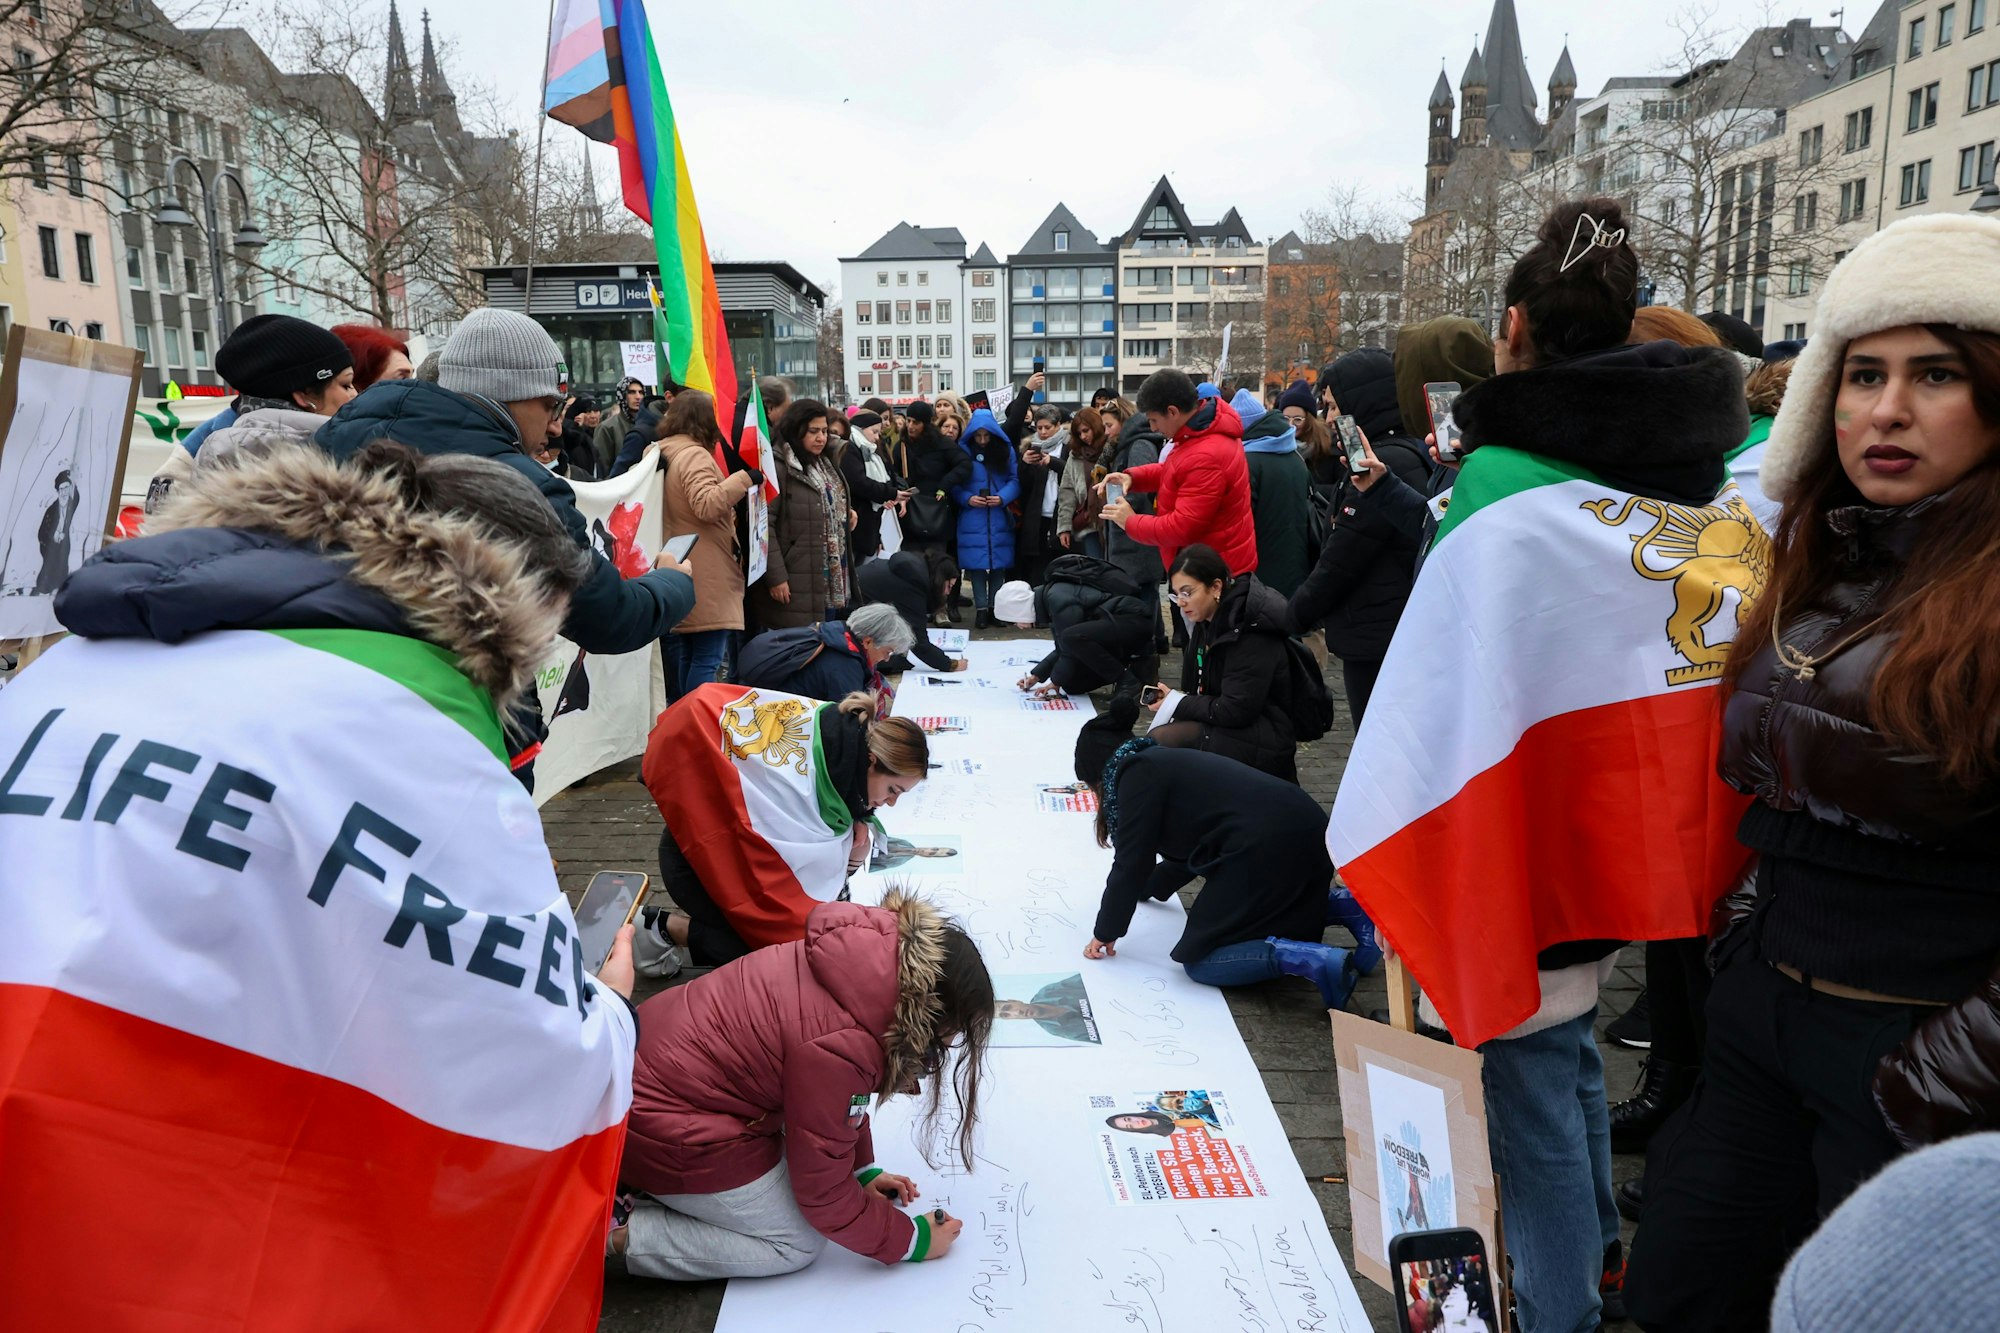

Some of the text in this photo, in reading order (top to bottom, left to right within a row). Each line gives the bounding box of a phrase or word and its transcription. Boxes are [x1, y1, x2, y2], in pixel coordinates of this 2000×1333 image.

[0, 708, 277, 872] LIFE
[1127, 1147, 1153, 1200] EIL-Petition nach
[1144, 1152, 1168, 1200] TODESURTEIL:
[1161, 1151, 1192, 1198] Retten Sie
[1176, 1129, 1210, 1198] meinen Vater,
[1189, 1127, 1229, 1198] Frau Baerbock,
[1209, 1139, 1237, 1175] Scholz!
[1235, 1145, 1269, 1197] #SaveSharmahd
[1383, 1138, 1418, 1165] FREEDOM
[1229, 1176, 1249, 1197] Herr
